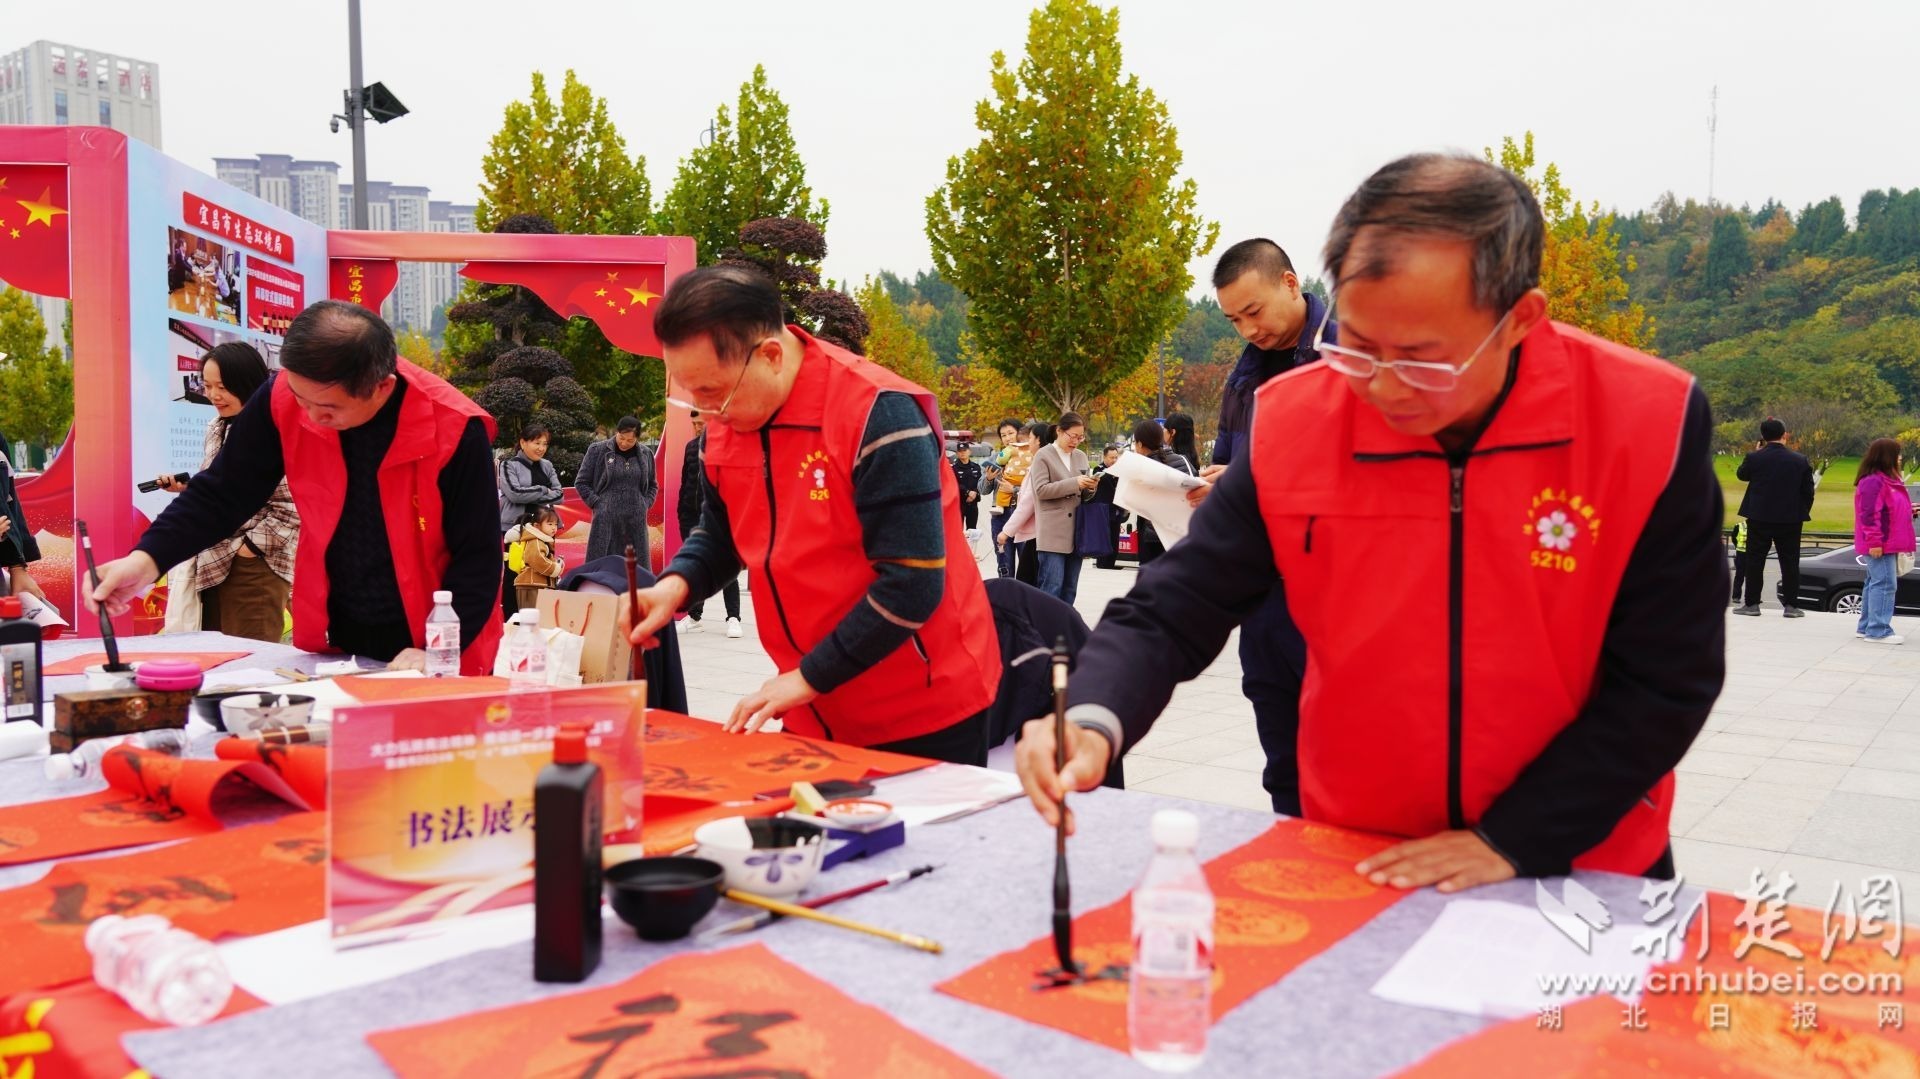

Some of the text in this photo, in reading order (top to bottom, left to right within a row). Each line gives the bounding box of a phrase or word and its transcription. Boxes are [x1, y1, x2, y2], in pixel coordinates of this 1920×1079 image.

[199, 203, 282, 255] 宜昌市生态环境局
[1531, 550, 1576, 572] 5210
